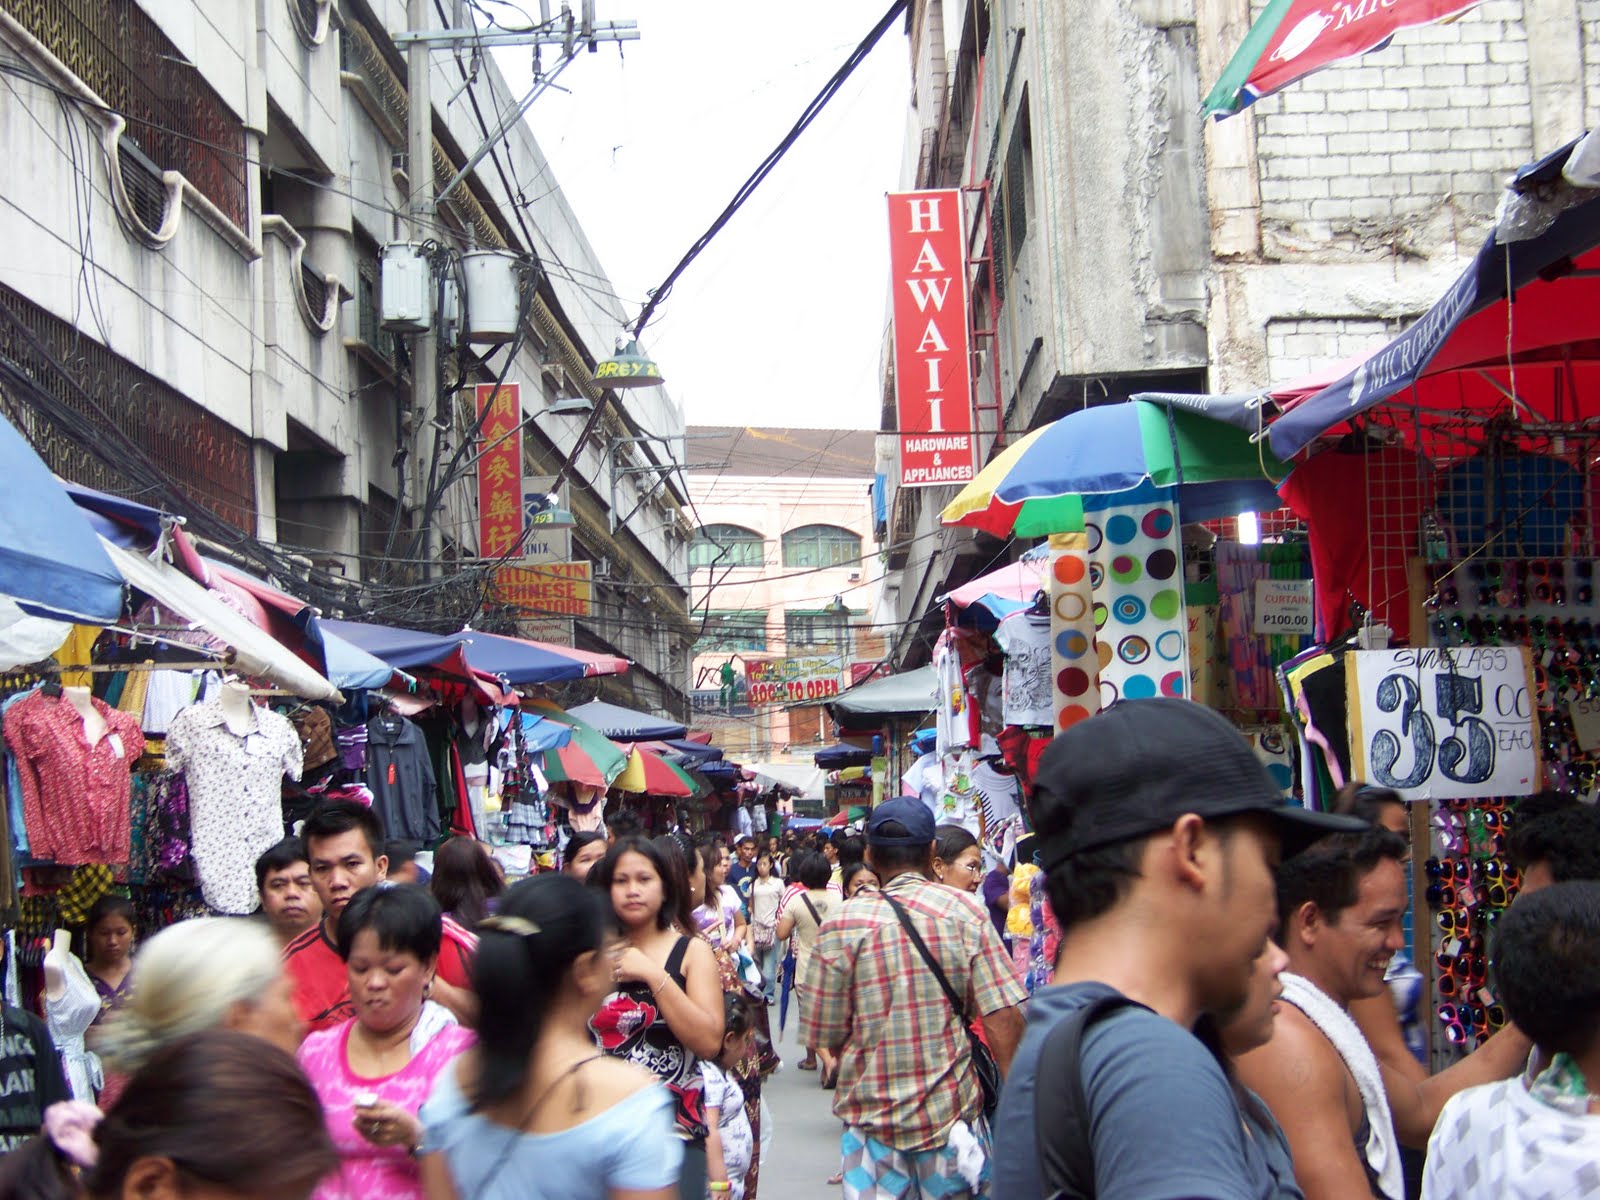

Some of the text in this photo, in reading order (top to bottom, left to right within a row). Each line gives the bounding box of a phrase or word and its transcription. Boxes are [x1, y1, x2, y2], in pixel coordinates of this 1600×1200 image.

[906, 198, 952, 433] HAWAII
[905, 437, 968, 453] HARDWARE
[933, 452, 942, 466] &
[904, 466, 972, 482] APPLIANCES
[494, 581, 577, 601] CHINESE
[1263, 614, 1308, 626] P100.00
[786, 681, 804, 700] TO
[806, 679, 838, 699] OPEN
[1371, 673, 1496, 788] 35
